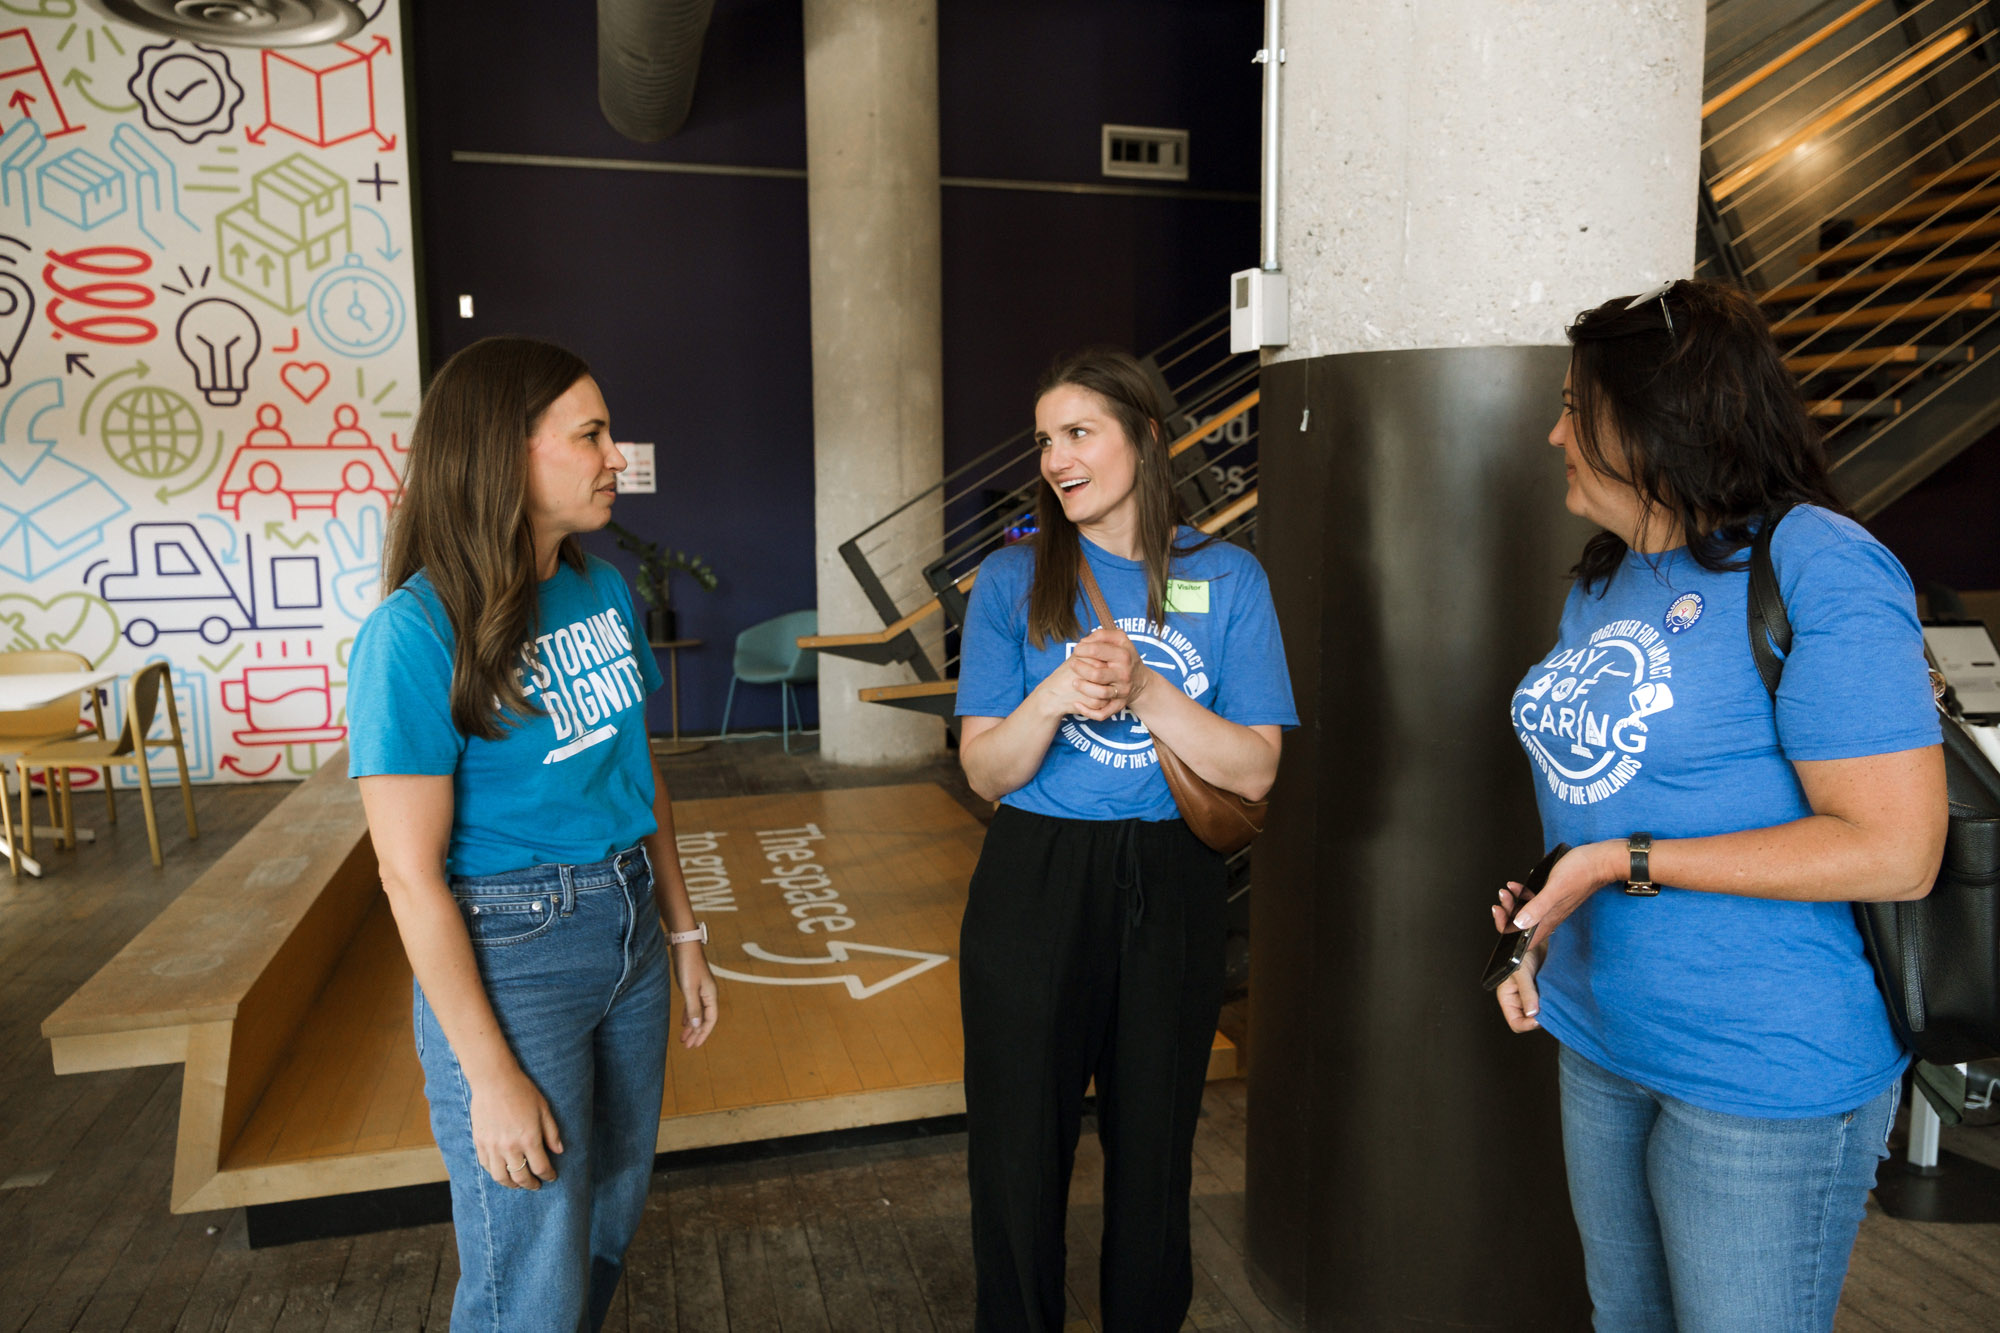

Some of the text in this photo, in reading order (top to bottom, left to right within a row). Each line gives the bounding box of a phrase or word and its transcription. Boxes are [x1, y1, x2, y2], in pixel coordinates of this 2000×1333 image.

[1177, 583, 1203, 591] Visitor
[1665, 593, 1702, 624] VOLUNTEERED
[510, 607, 632, 699] STORING
[1167, 630, 1204, 670] IMPACT
[1544, 648, 1608, 674] DAY
[1588, 619, 1672, 680] TOGETHER FOR IMPACT
[1551, 677, 1599, 703] OF
[1061, 722, 1091, 752] UNITED
[1089, 744, 1114, 765] WAY
[1113, 753, 1127, 769] OF
[1128, 752, 1148, 769] THE
[1520, 700, 1648, 759] CARING
[1520, 731, 1643, 805] UNITED WAY OF THE MIDLANDS
[676, 832, 738, 911] to grow
[756, 823, 856, 934] The space
